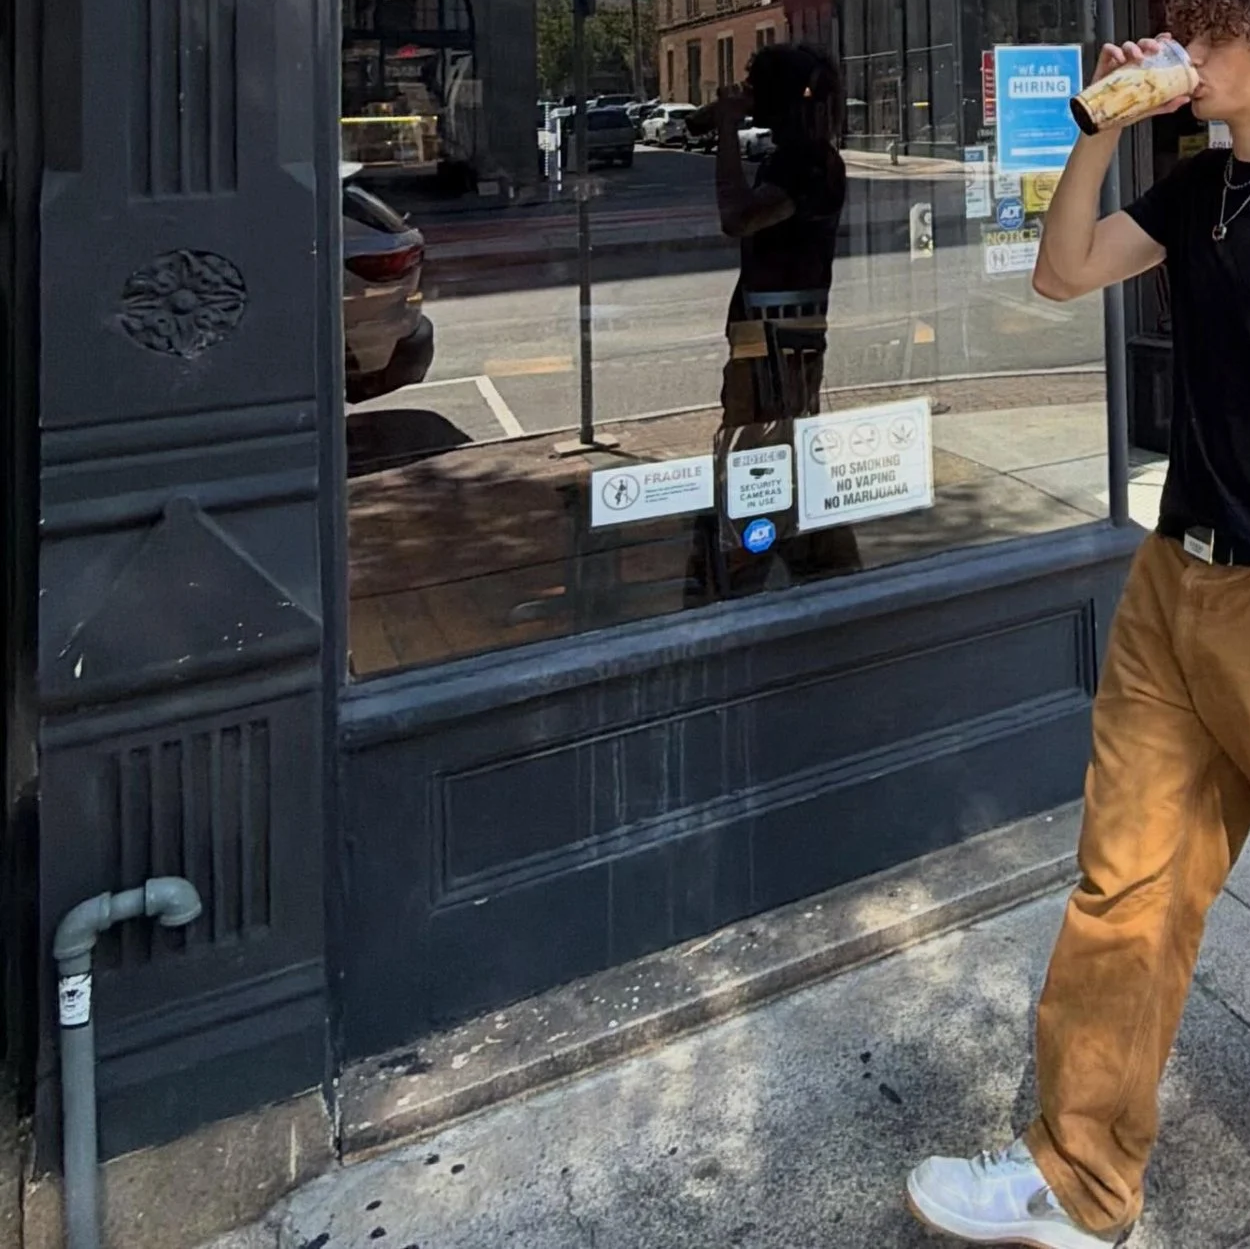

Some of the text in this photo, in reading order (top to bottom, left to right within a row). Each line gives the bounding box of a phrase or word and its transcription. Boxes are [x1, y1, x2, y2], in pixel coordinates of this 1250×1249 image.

[1013, 80, 1067, 92] HIRING
[986, 228, 1038, 245] NOTICE
[831, 453, 901, 479] NO SMOKING
[643, 465, 703, 485] FRAGILE
[836, 470, 897, 493] NO VAPING
[740, 478, 782, 493] SECURITY
[740, 488, 782, 501] CAMERAS
[747, 497, 775, 508] IN USE
[824, 482, 909, 510] NO MARIJUANA
